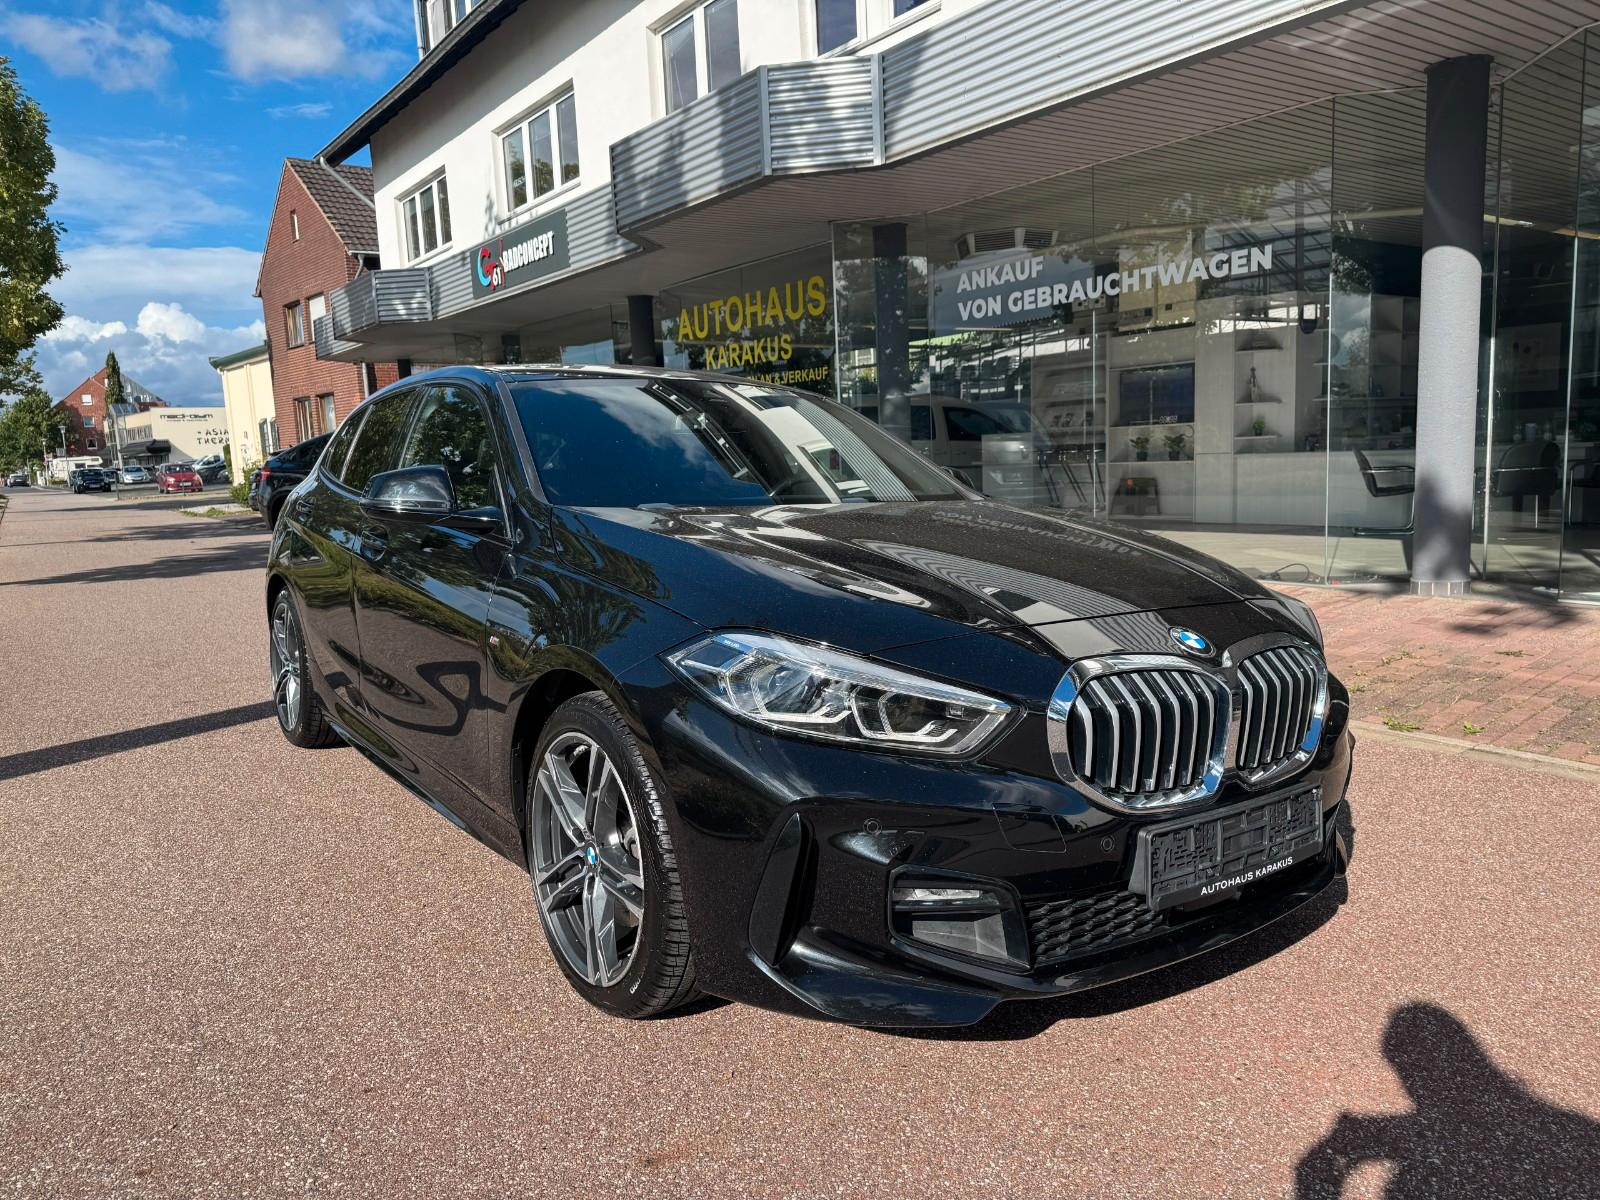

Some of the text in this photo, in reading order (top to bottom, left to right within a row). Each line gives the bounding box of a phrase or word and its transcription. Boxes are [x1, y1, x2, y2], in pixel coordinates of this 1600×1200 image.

[502, 231, 554, 273] BADCONCEPT
[956, 255, 1045, 294] ANKAUF
[957, 244, 1273, 321] VON GEBRAUCHTWAGEN
[677, 275, 826, 343] AUTOHAUS
[705, 334, 793, 371] KARAKUS
[782, 366, 829, 385] VERKAUF
[1200, 856, 1294, 896] AUTOHAUS KARAKUS
